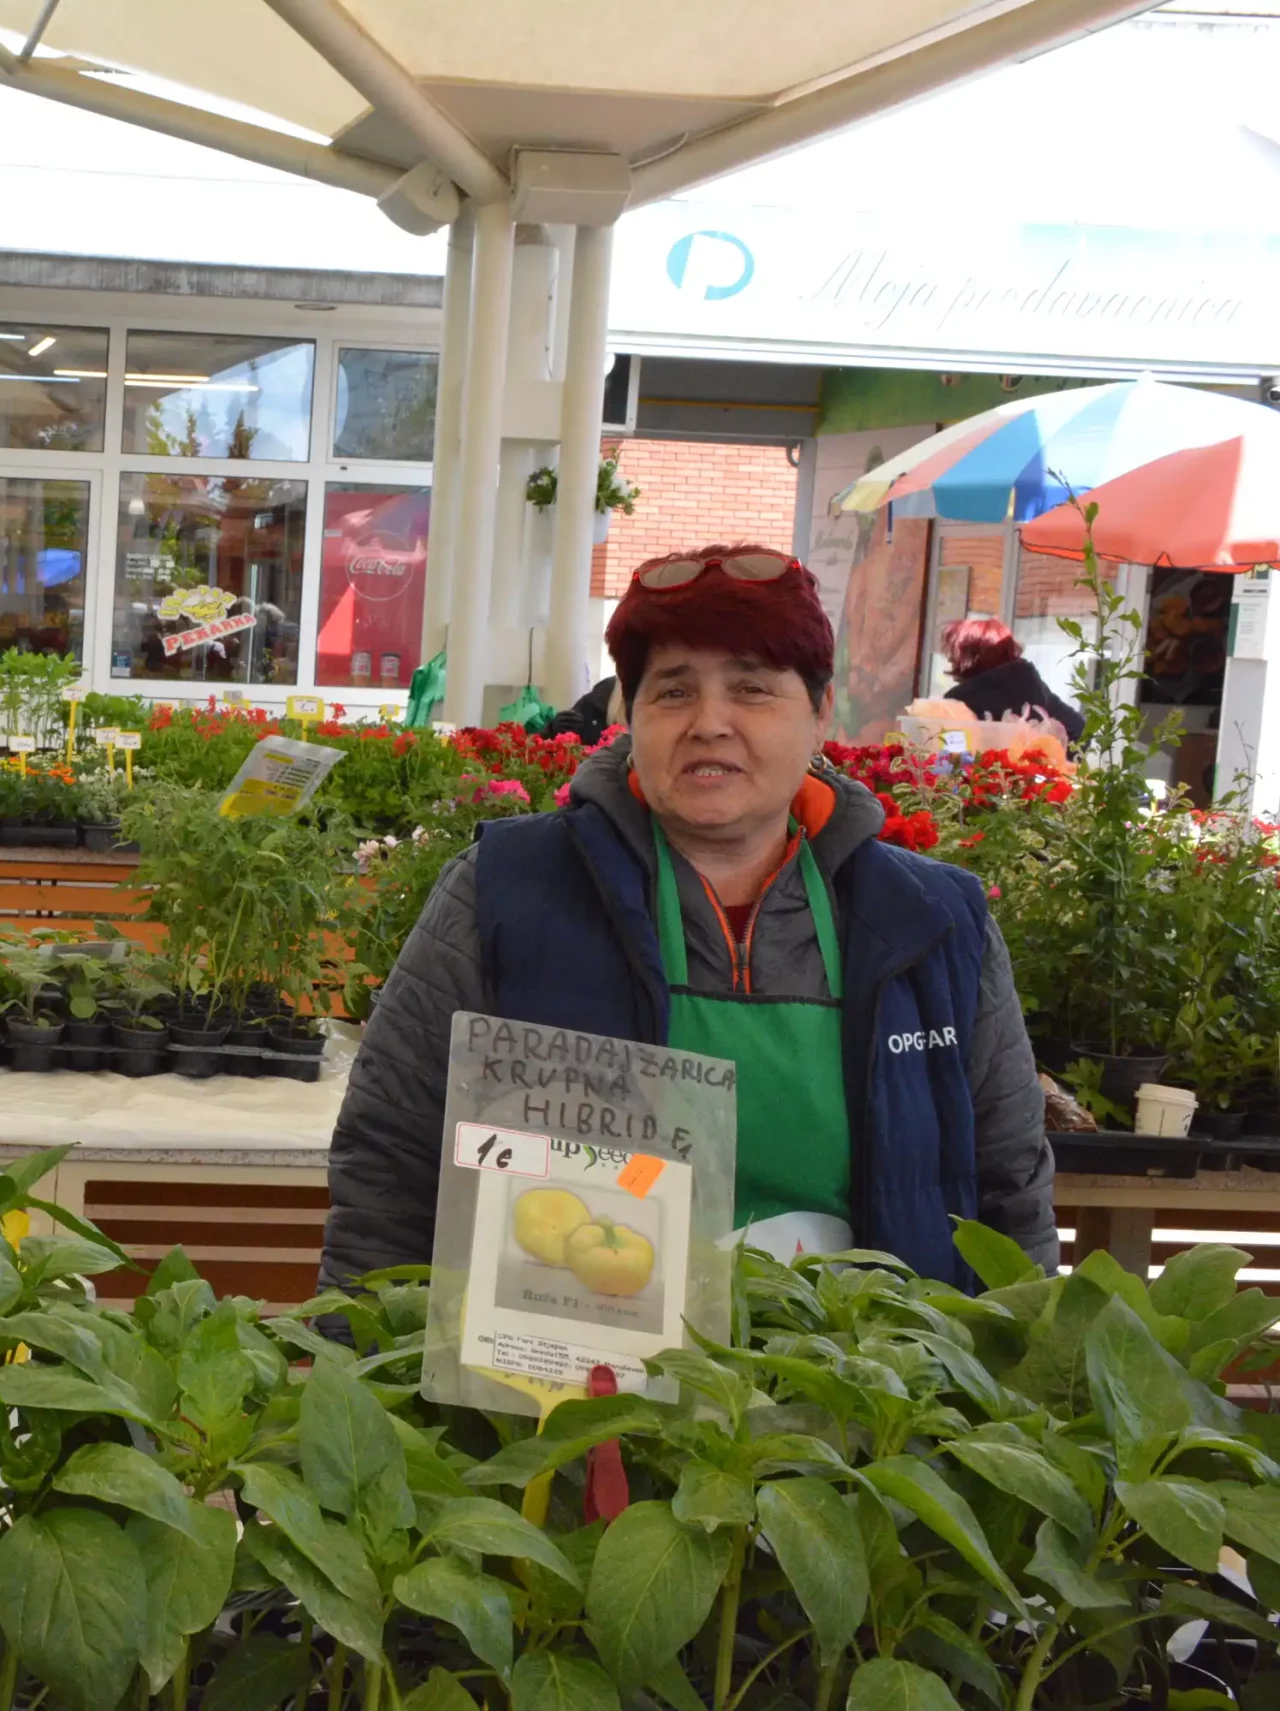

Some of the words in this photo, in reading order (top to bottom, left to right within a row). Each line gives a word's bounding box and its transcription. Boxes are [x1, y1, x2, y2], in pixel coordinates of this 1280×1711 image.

[887, 1031, 924, 1054] OPG
[481, 1055, 631, 1100] KRUPNA
[523, 1093, 658, 1141] HIBRID
